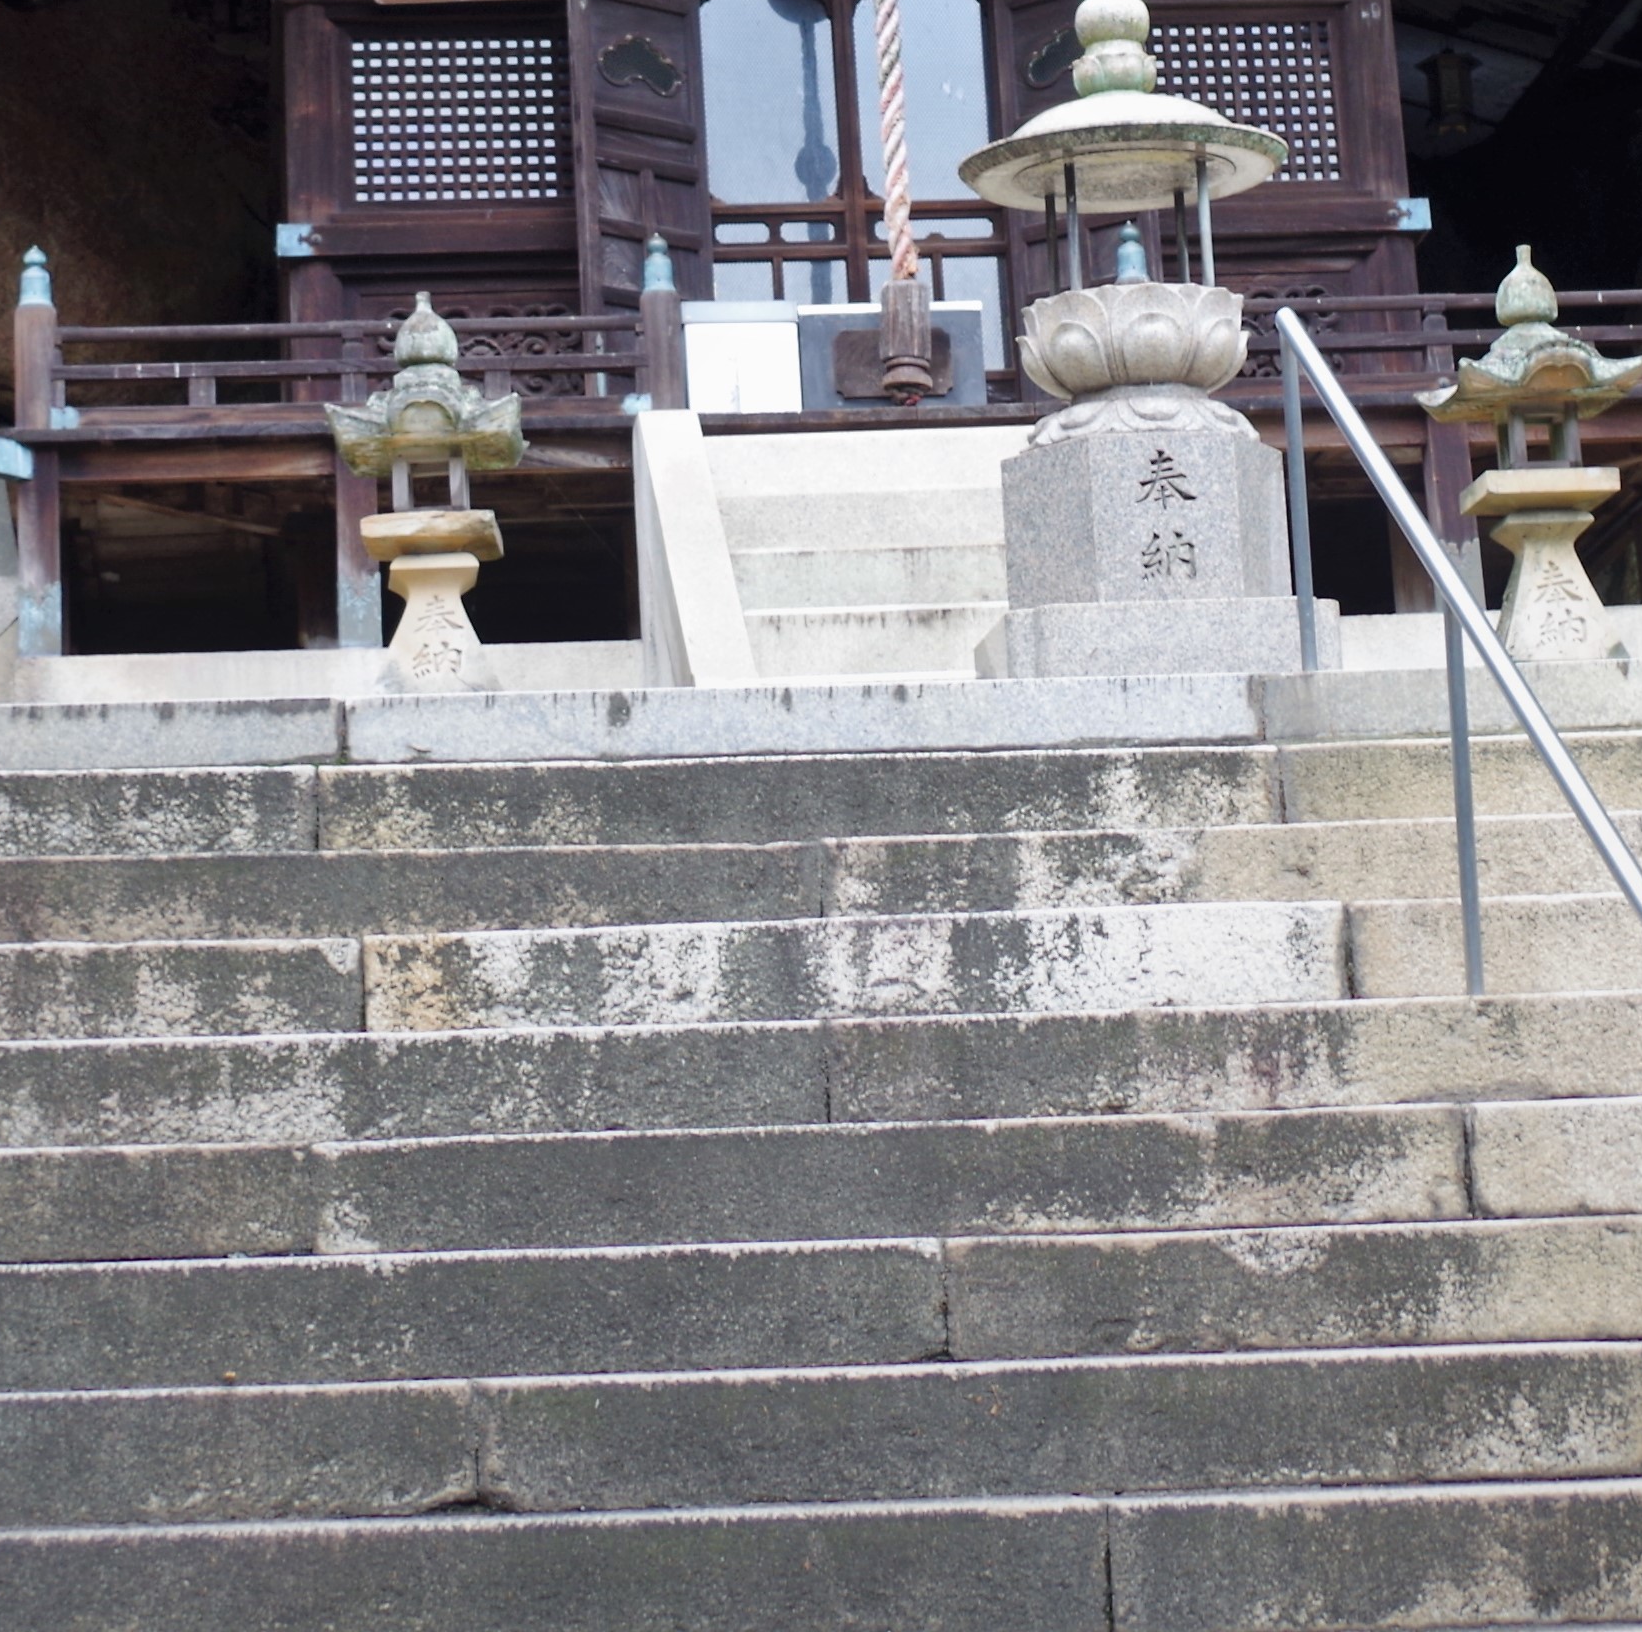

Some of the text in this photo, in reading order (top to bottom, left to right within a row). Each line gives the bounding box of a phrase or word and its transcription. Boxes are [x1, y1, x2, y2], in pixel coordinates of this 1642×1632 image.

[1135, 449, 1197, 580] 奉納
[413, 594, 465, 678] 奉納
[1534, 559, 1587, 647] 奉納
